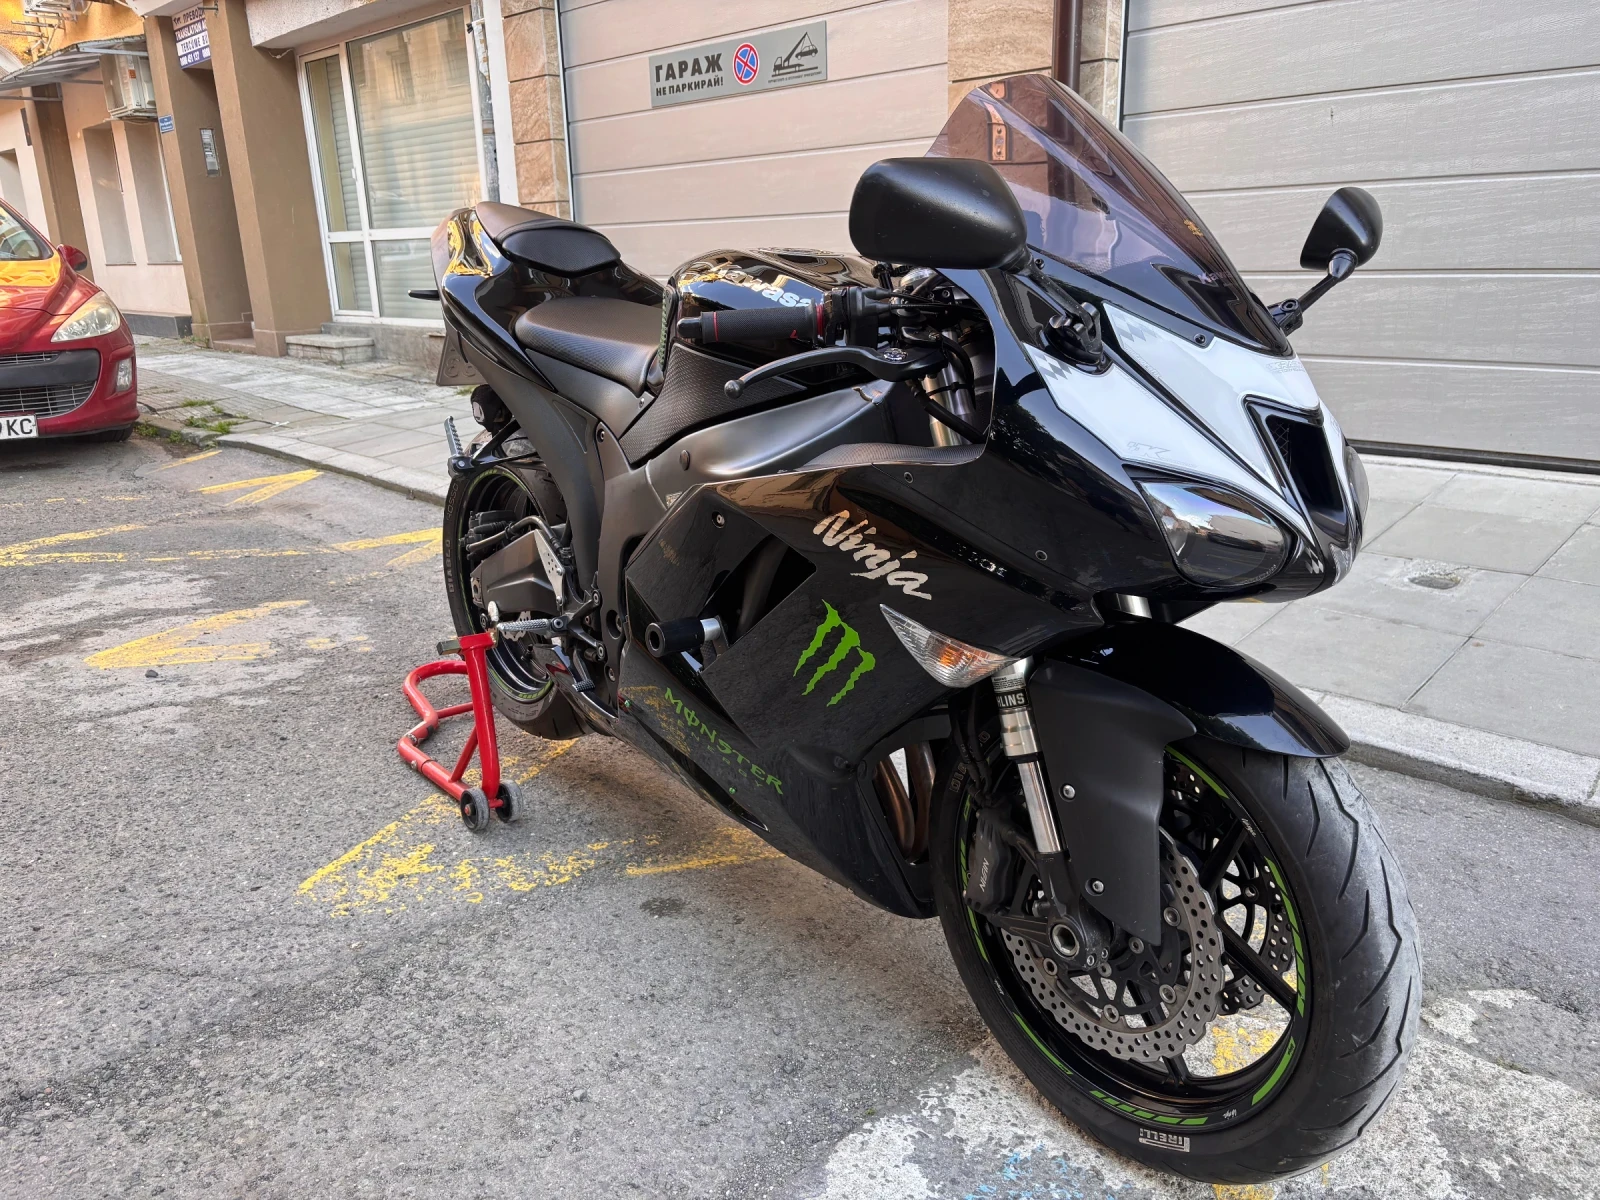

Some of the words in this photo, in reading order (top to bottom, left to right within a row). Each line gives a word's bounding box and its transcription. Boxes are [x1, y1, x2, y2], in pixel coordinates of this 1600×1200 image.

[655, 53, 723, 83] ГАРАЖ
[656, 87, 667, 97] НЕ
[668, 76, 724, 95] ПАРКИРАЙ!
[445, 539, 456, 593] DIABLO
[812, 509, 933, 601] Ninja
[664, 687, 784, 796] MONSTER
[1138, 1127, 1191, 1153] PIRELLI
